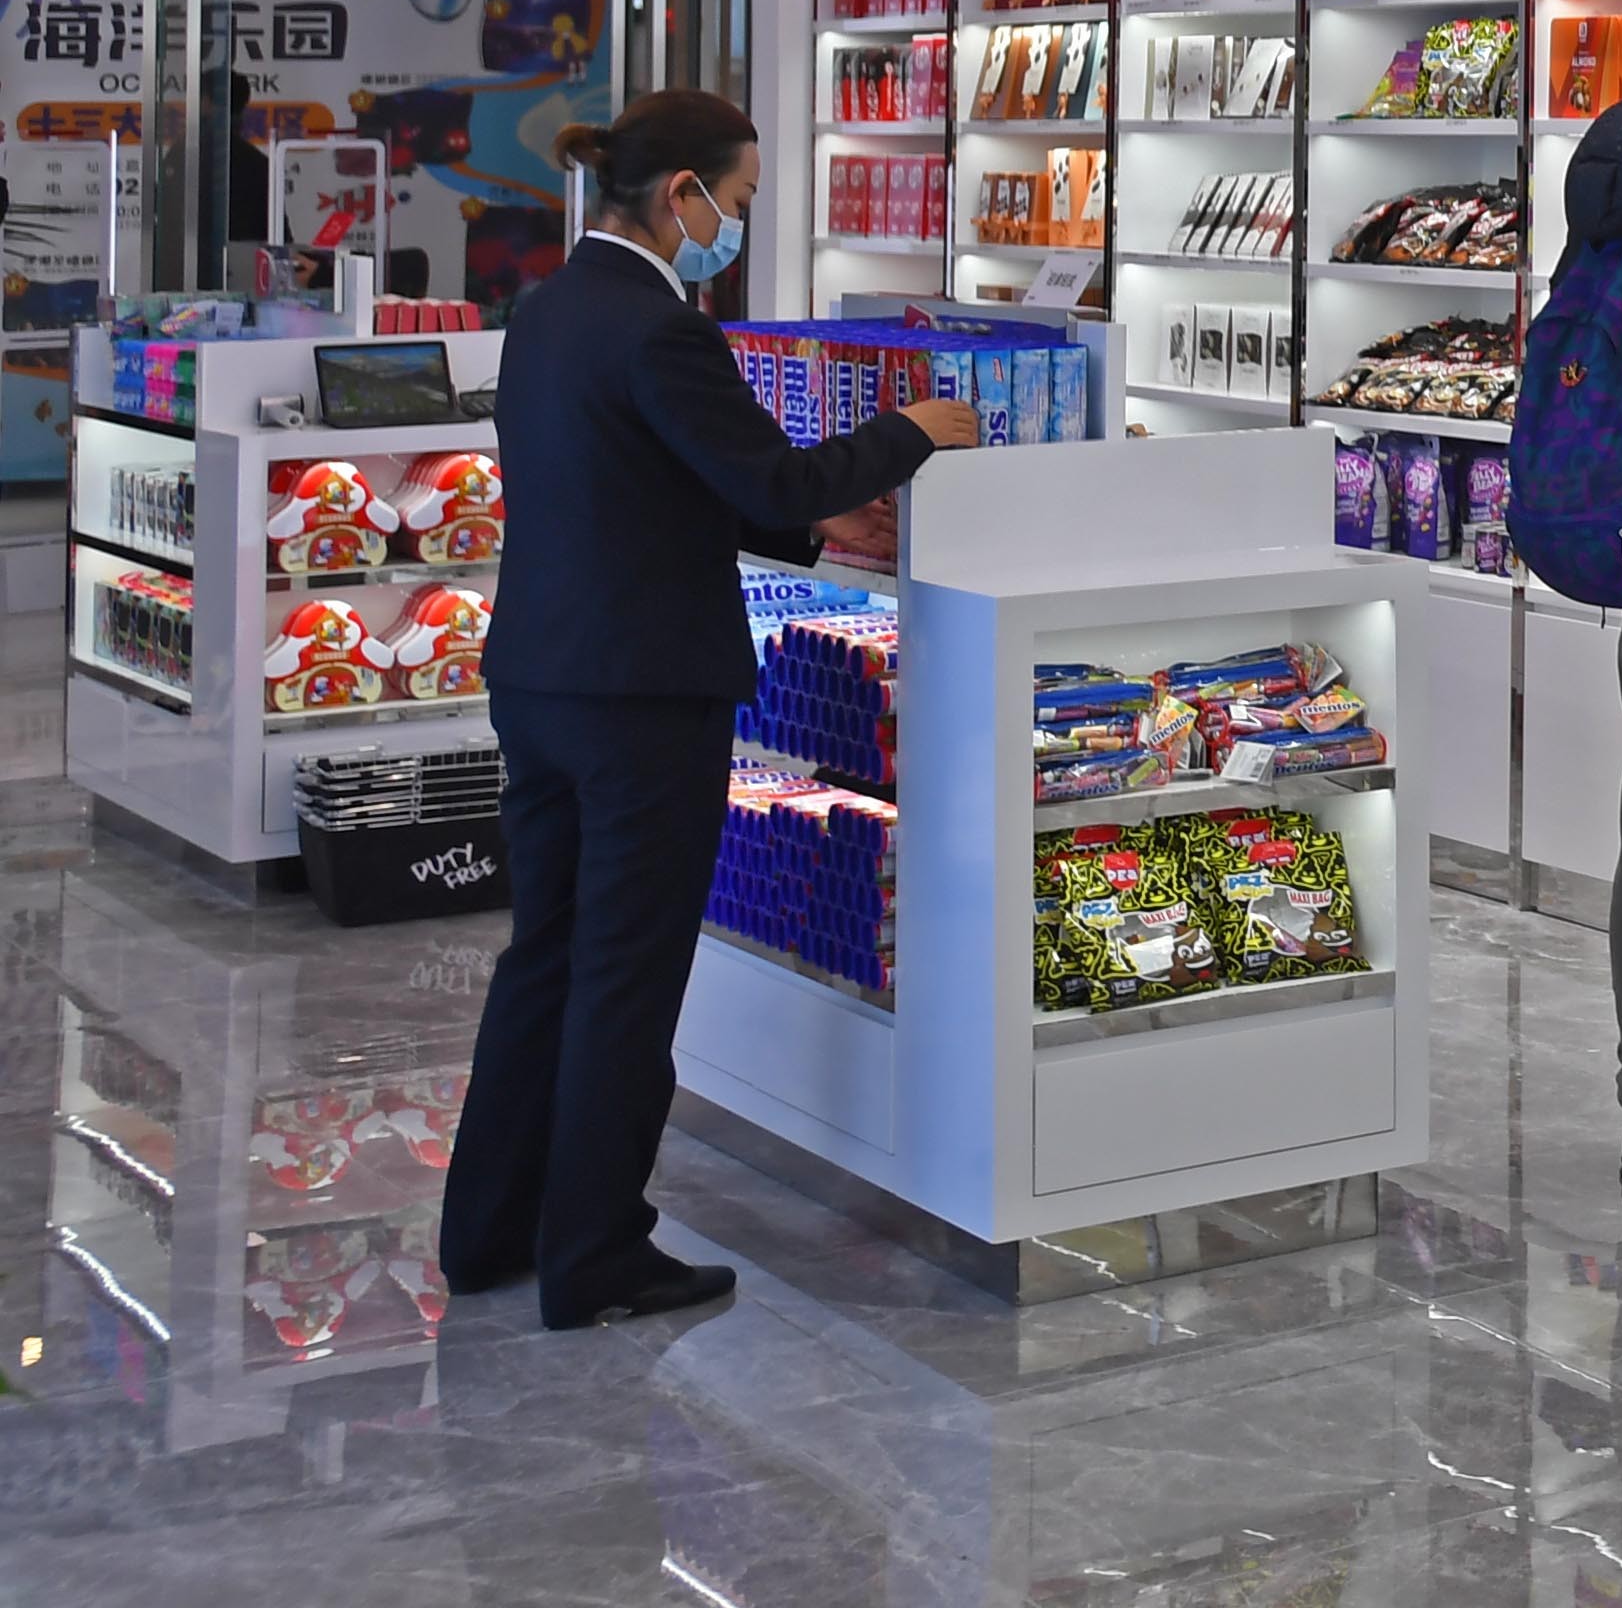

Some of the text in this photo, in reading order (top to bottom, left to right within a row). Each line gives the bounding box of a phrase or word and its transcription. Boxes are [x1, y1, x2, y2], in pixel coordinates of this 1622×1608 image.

[744, 580, 812, 605] ntos
[1300, 700, 1362, 713] mentos
[1150, 711, 1196, 745] mentos
[410, 840, 475, 885] DUTY
[444, 855, 497, 891] FREE
[1228, 874, 1263, 889] PEZ
[1289, 890, 1332, 906] MAXI BAG
[1082, 902, 1116, 918] PEZ
[1143, 909, 1167, 926] MAXI
